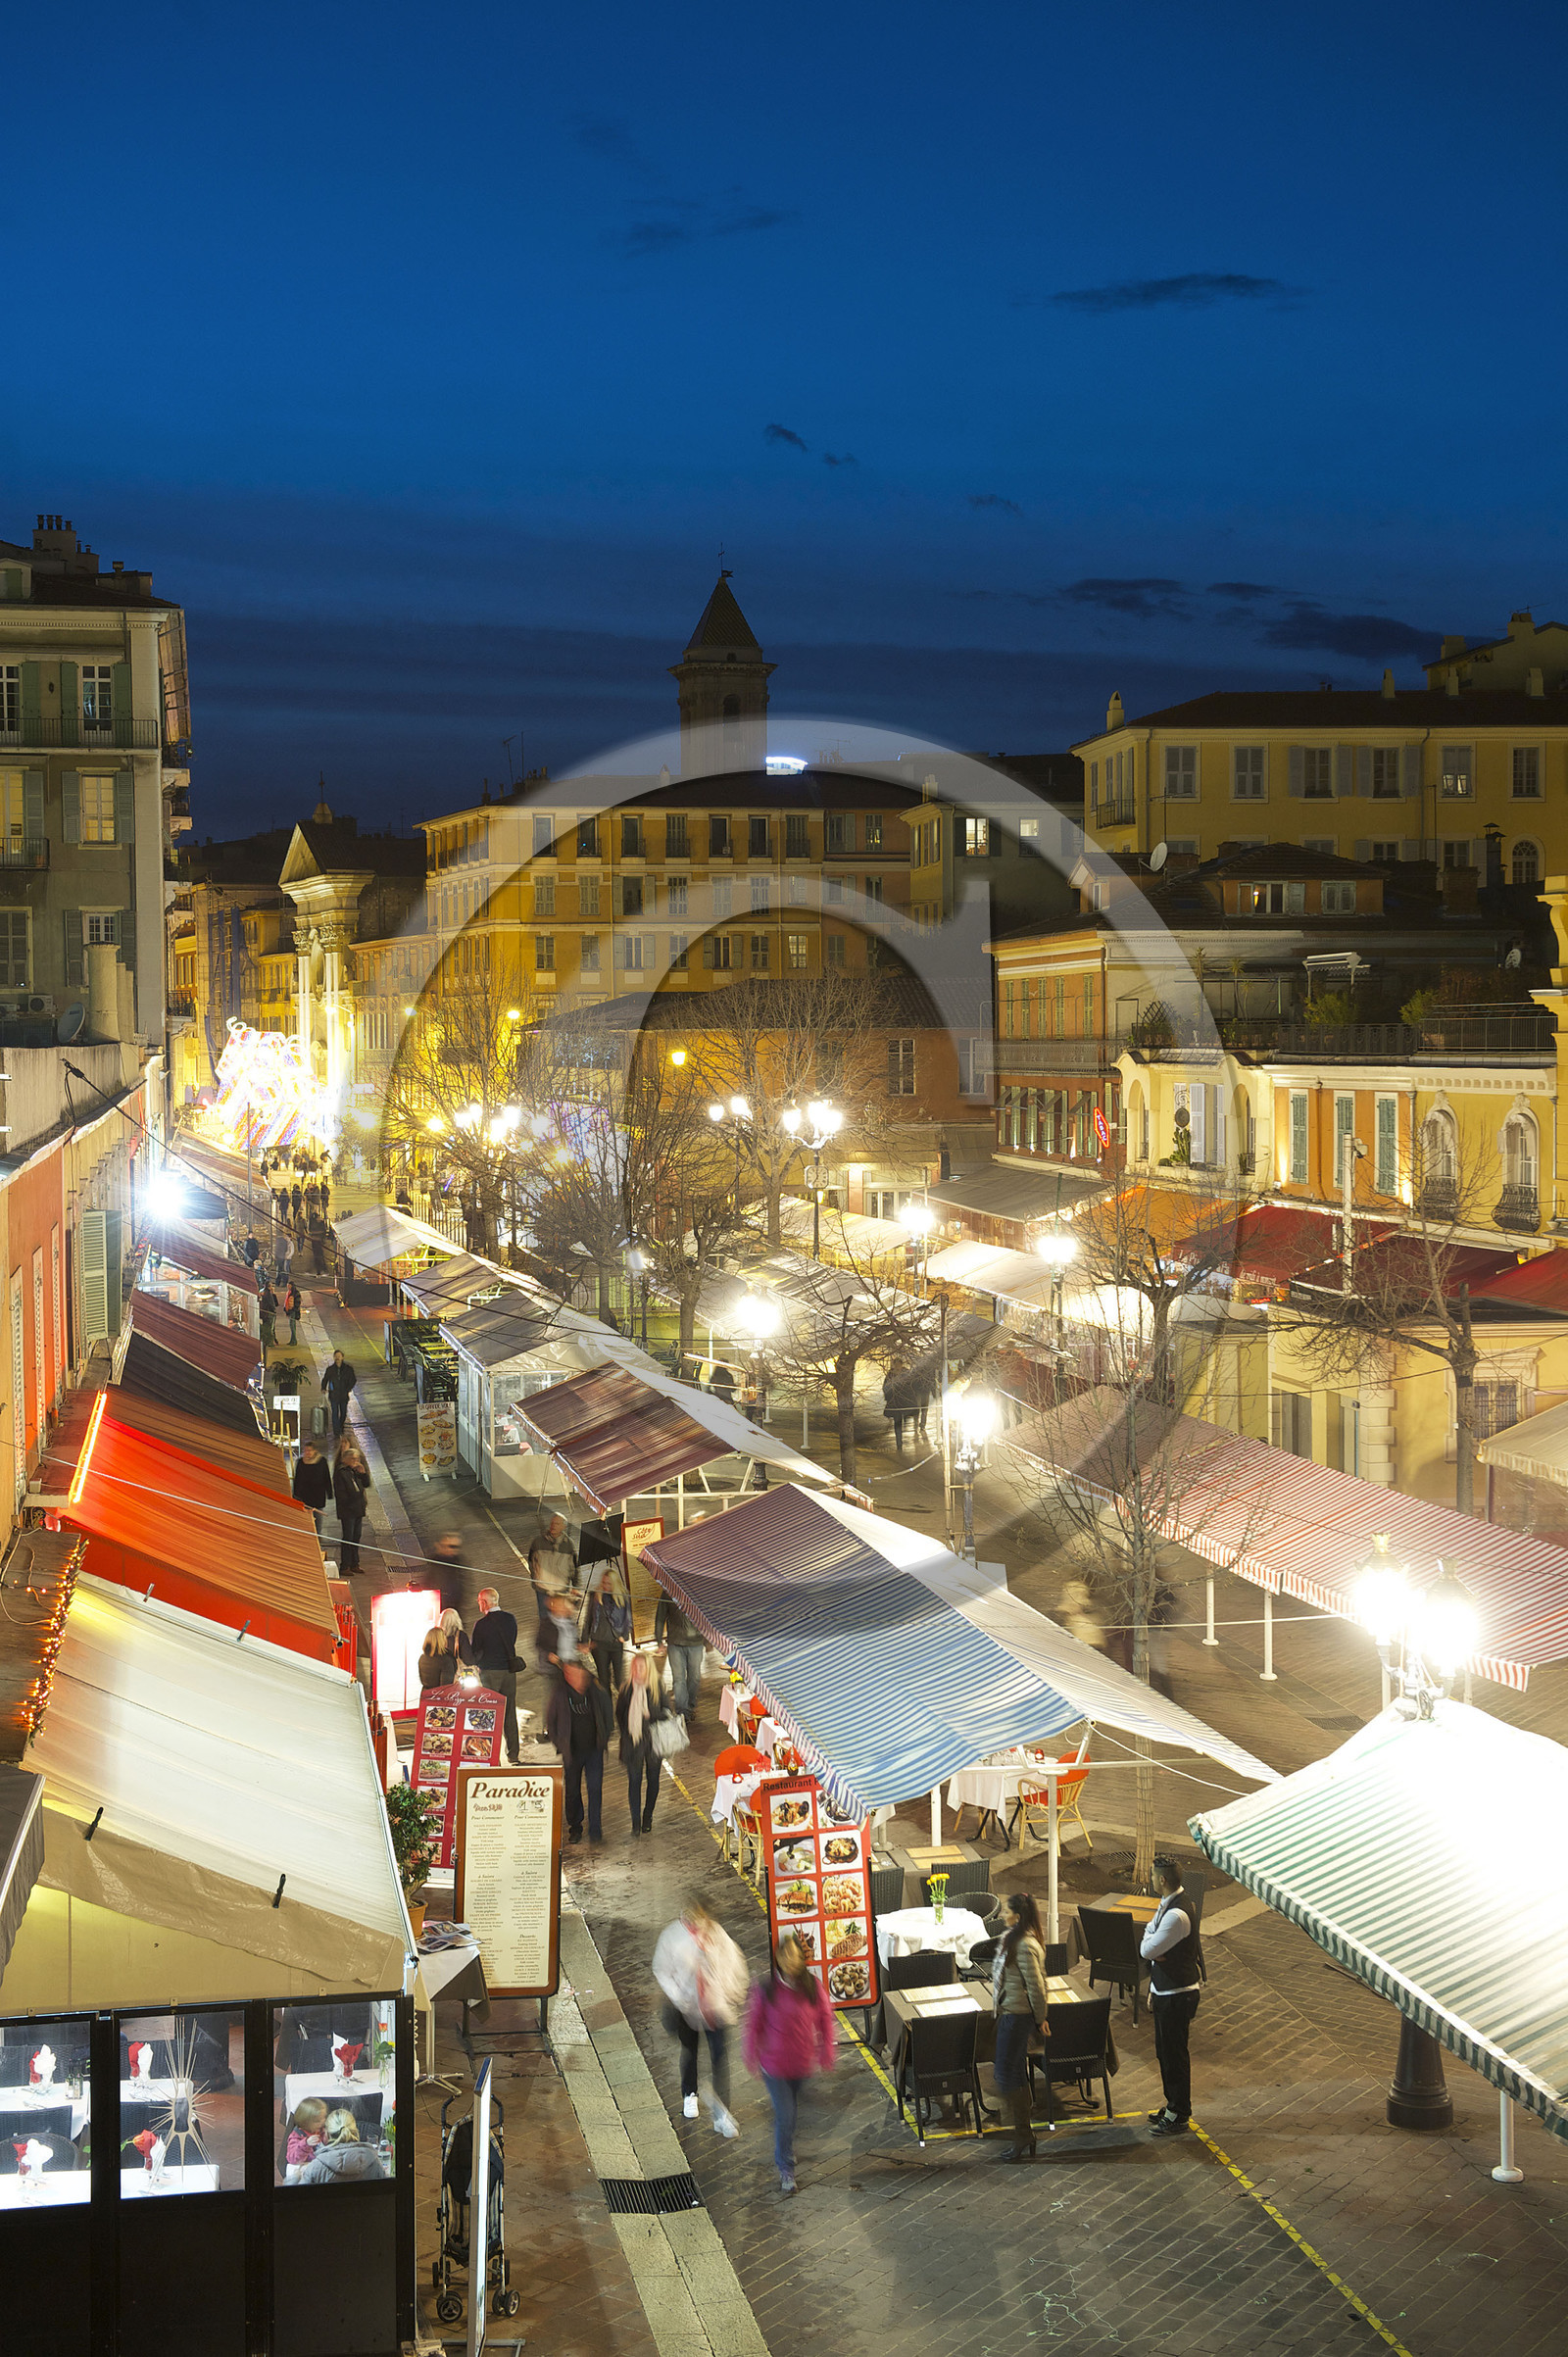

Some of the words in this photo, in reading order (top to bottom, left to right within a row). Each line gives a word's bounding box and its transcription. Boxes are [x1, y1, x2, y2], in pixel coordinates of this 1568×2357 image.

[1096, 1114, 1107, 1141] TABAC
[470, 1780, 550, 1798] Paradice
[763, 1779, 811, 1791] Restaurant
